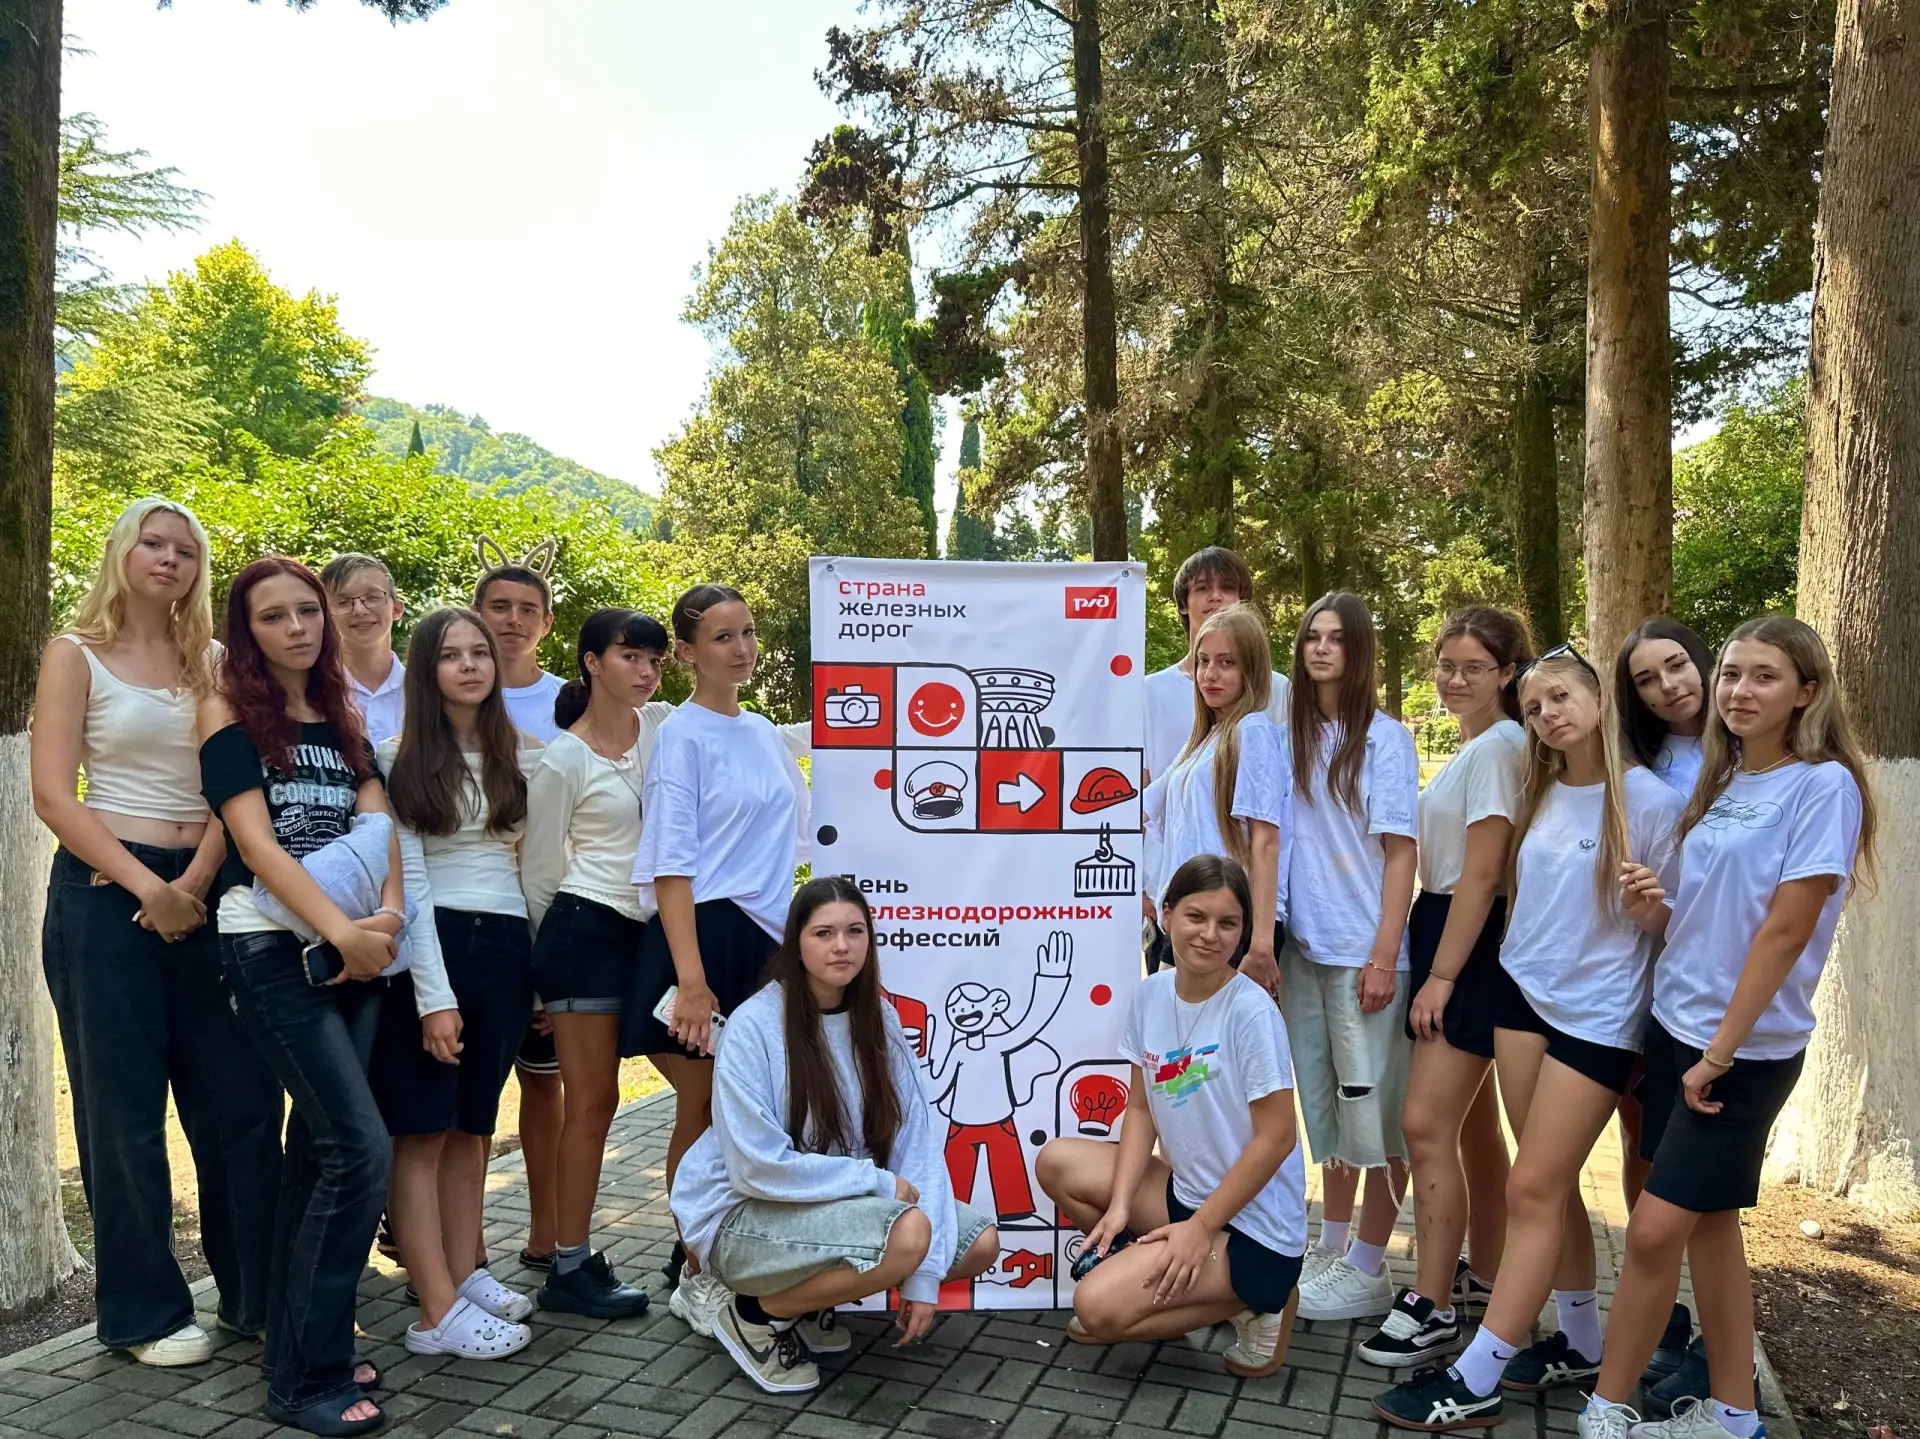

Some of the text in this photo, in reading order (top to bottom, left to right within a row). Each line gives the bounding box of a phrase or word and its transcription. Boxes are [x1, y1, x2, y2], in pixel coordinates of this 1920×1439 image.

[839, 581, 926, 600] страна
[839, 602, 967, 618] железных
[838, 623, 914, 643] дорог
[308, 810, 339, 818] PERFECT
[868, 904, 1113, 925] елезнодорожных
[874, 927, 1000, 951] офессий
